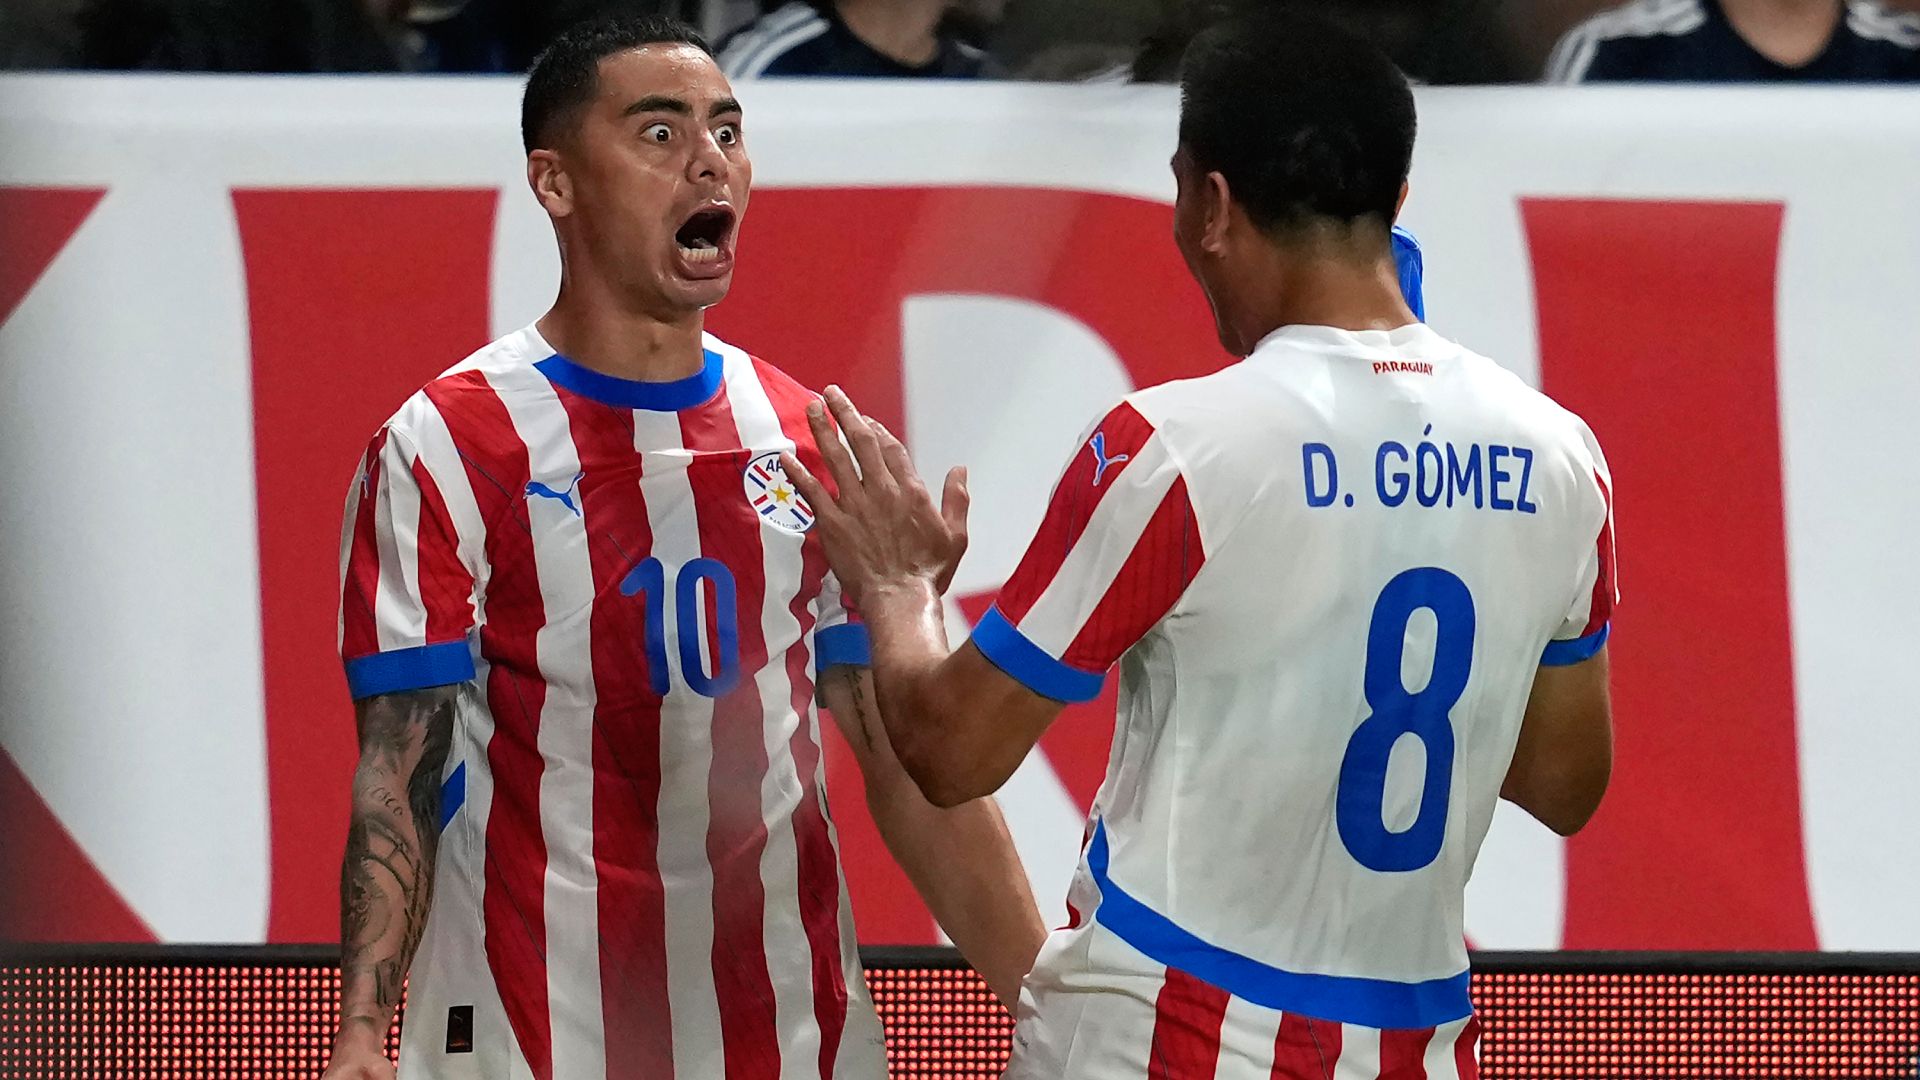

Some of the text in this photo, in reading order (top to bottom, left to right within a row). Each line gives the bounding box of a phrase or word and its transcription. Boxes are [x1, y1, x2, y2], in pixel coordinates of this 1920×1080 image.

[1372, 360, 1434, 376] PARAGUAY
[1302, 423, 1537, 514] D. GÓMEZ
[620, 556, 740, 698] 10
[1336, 566, 1476, 873] 8
